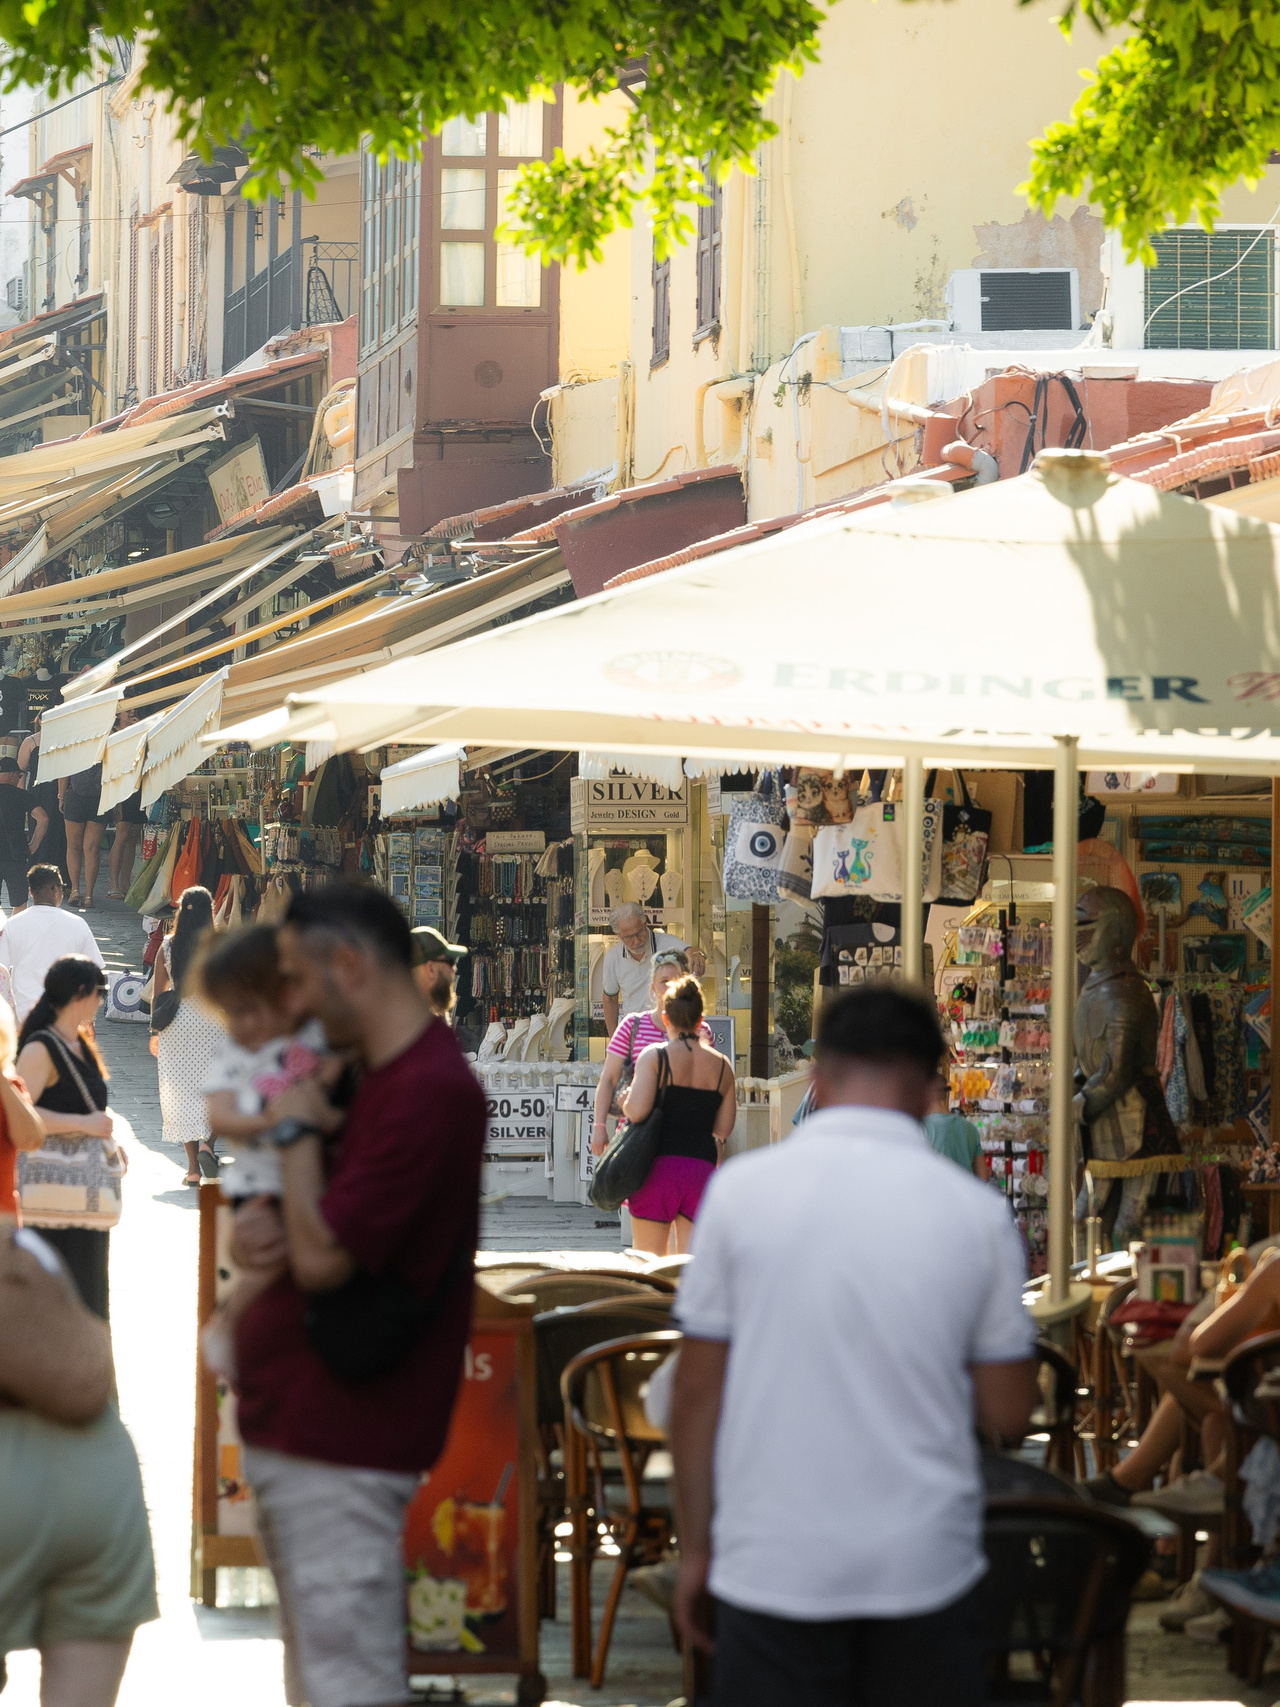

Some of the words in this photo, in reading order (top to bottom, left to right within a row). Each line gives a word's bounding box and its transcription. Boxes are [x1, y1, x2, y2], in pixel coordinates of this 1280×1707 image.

[773, 662, 1212, 704] ERDINGER
[590, 810, 616, 819] Jewelry
[617, 809, 657, 819] DESIGN
[663, 811, 680, 819] Gold
[489, 1126, 546, 1138] SILVER
